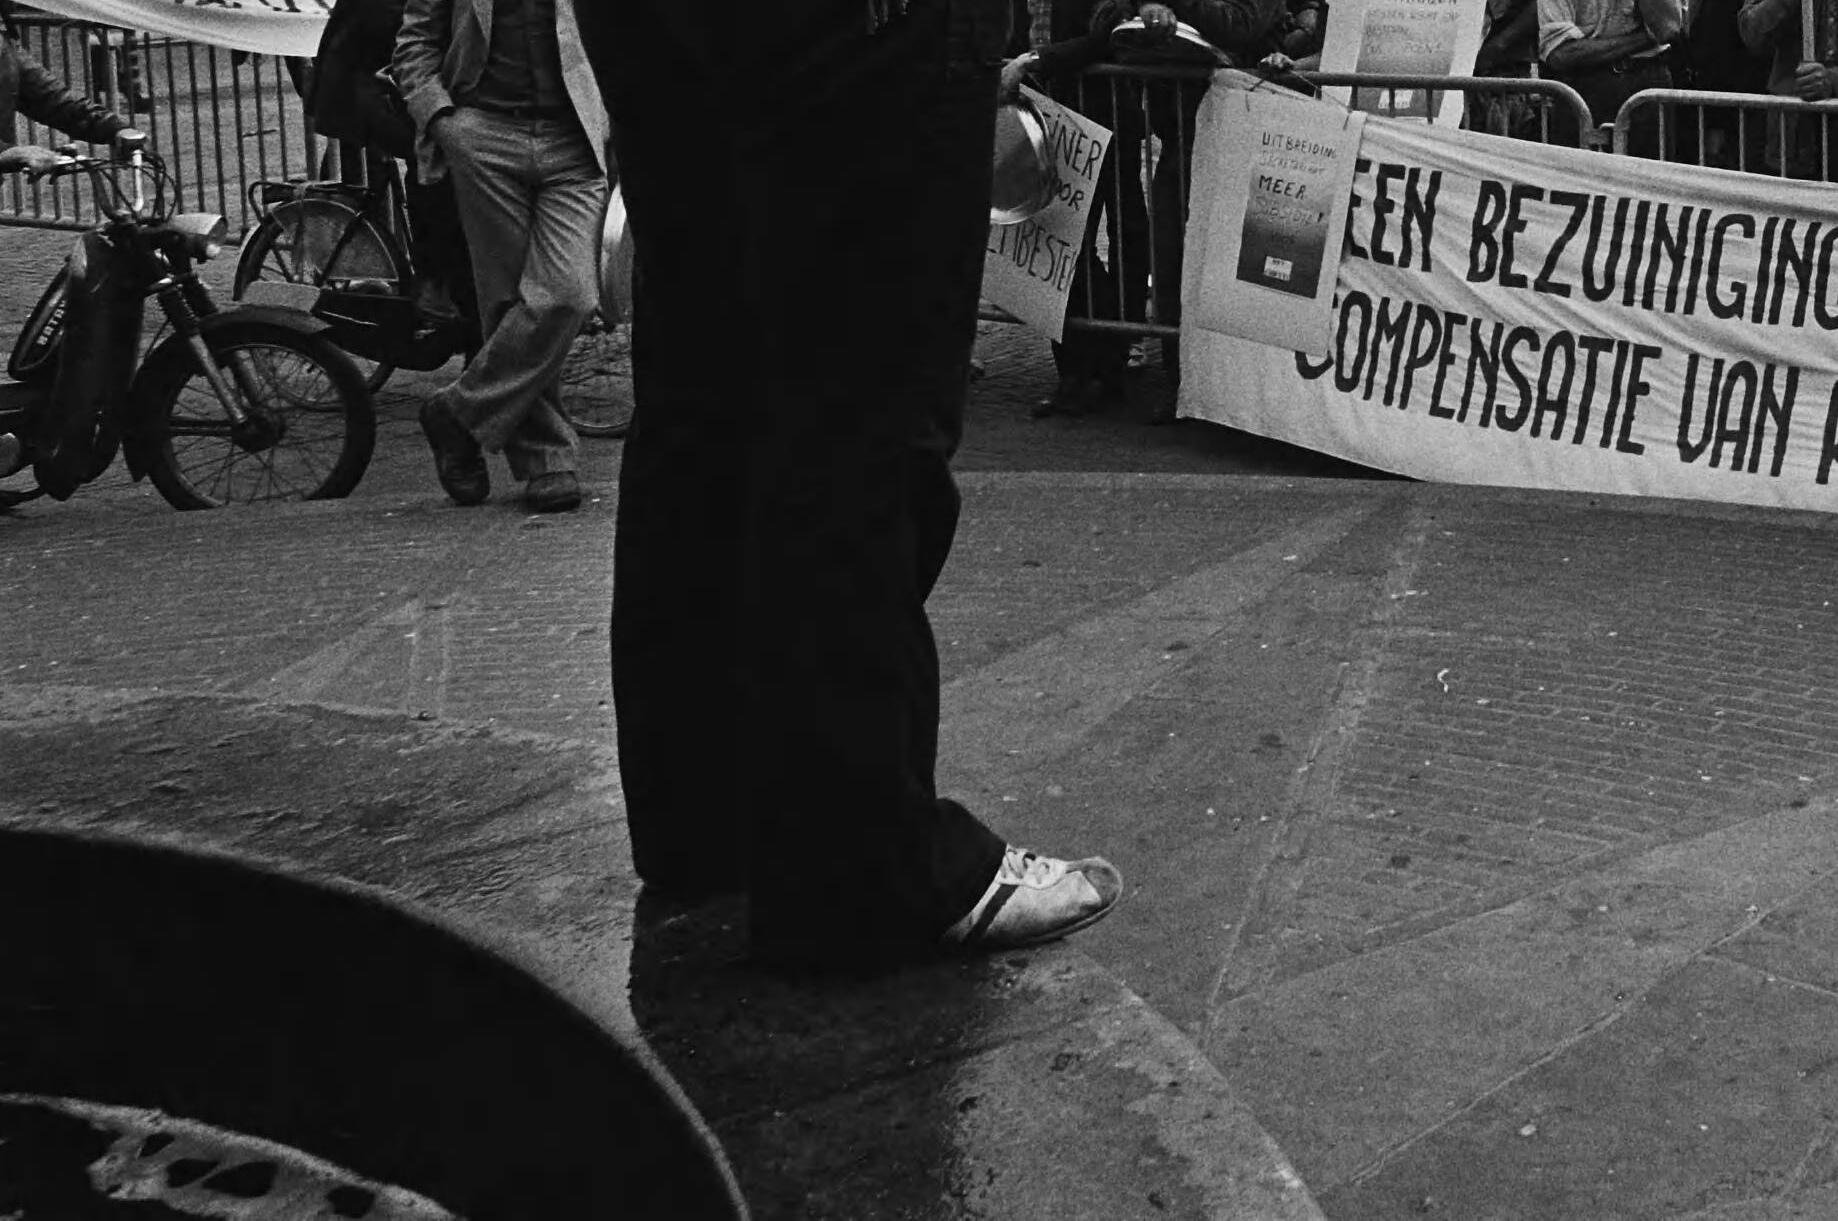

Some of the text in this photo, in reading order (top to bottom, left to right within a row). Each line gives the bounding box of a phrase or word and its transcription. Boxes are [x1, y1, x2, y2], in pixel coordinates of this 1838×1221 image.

[1258, 175, 1306, 200] MEER
[1345, 159, 1442, 273] EEN
[1677, 353, 1800, 476] VAN
